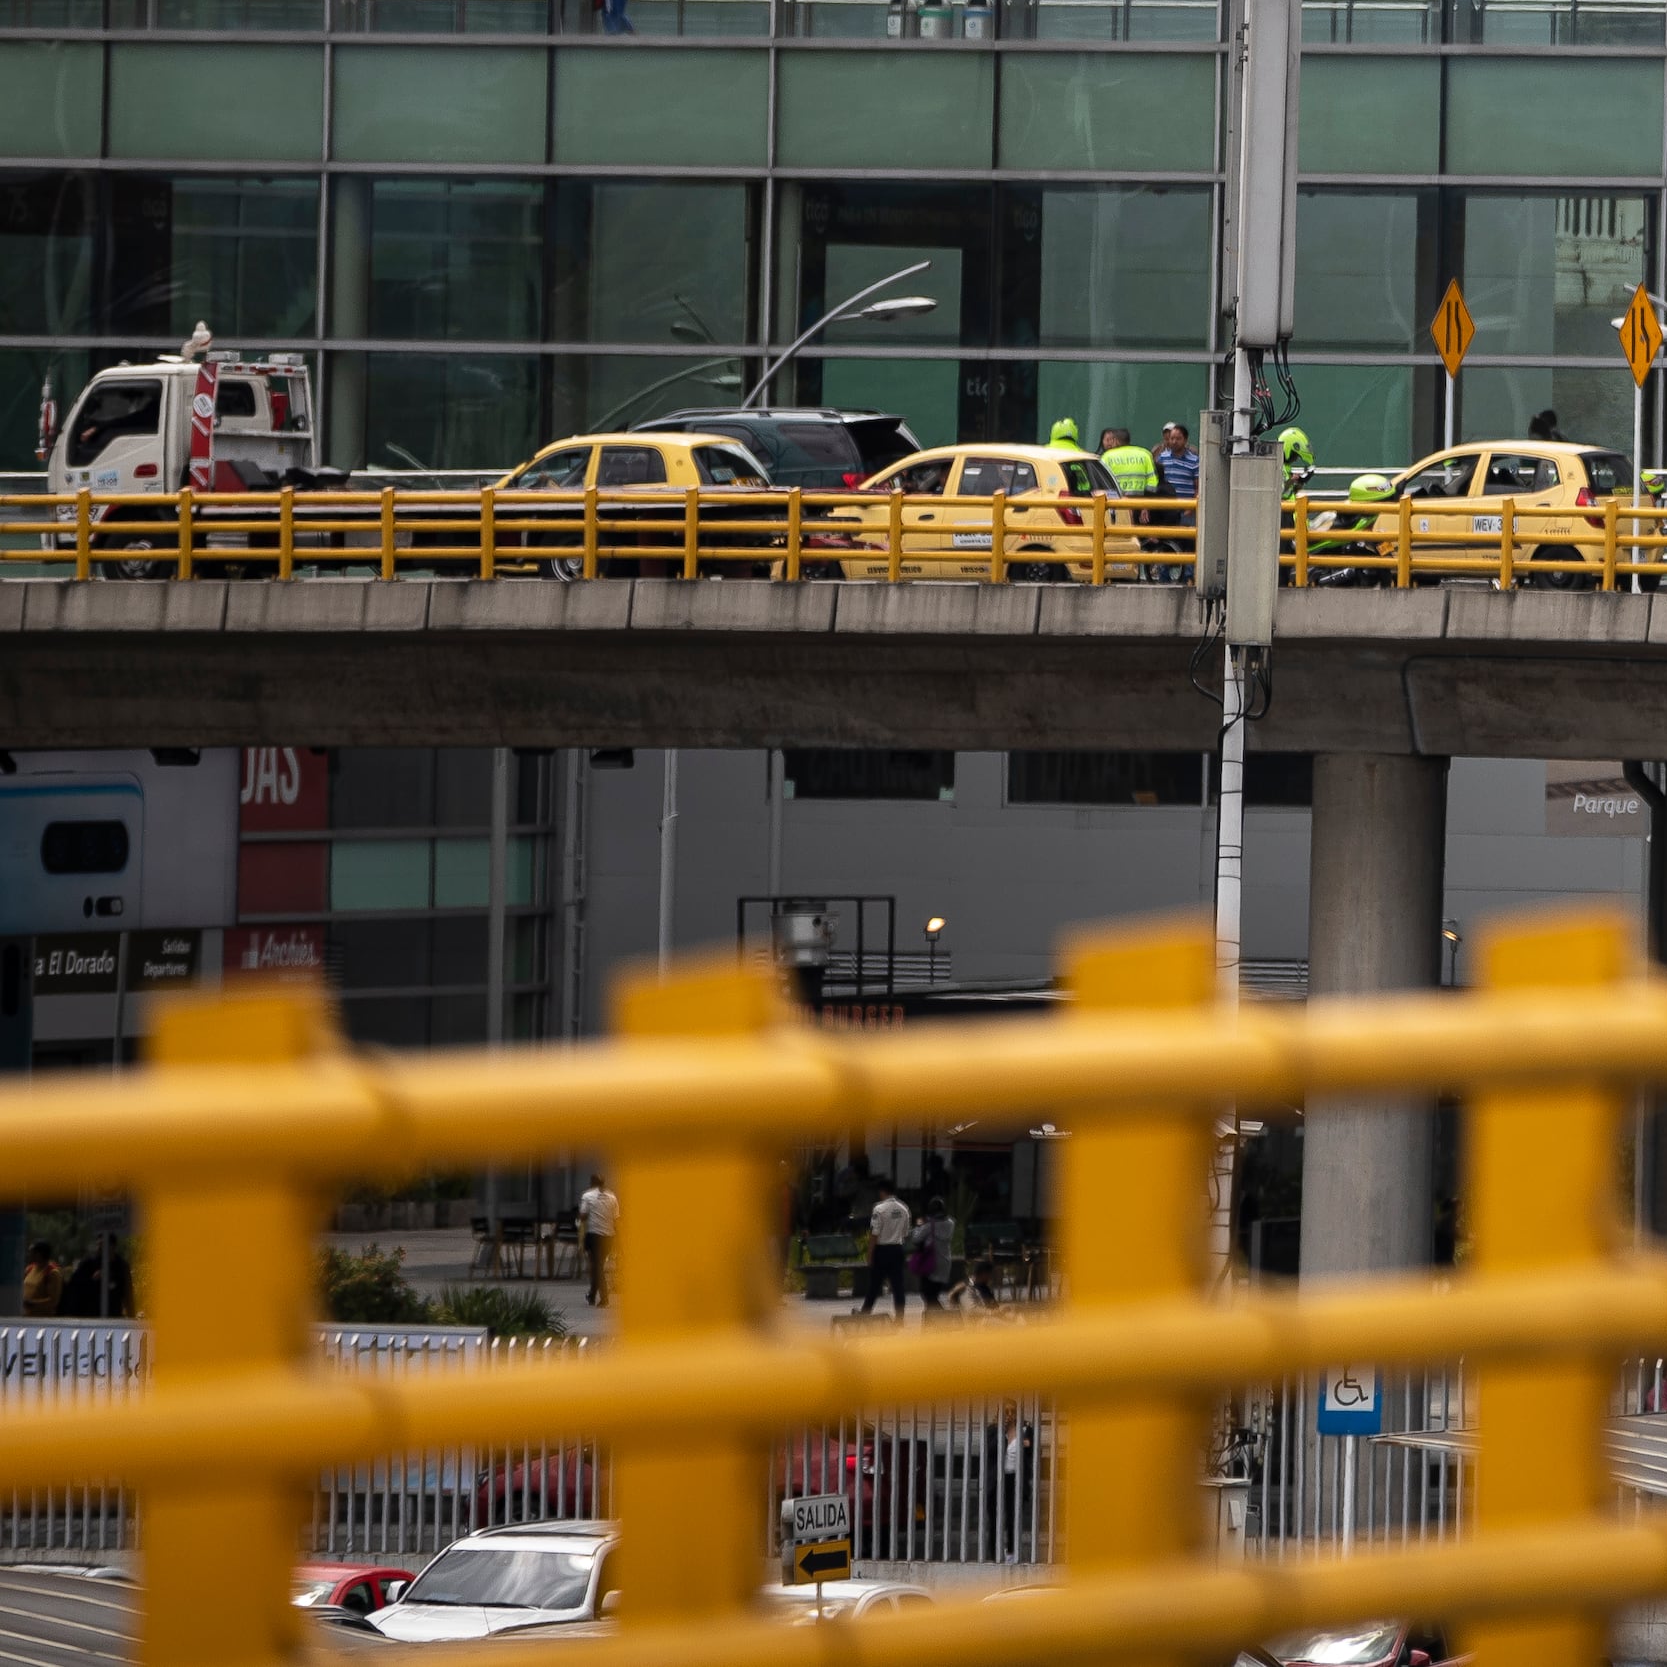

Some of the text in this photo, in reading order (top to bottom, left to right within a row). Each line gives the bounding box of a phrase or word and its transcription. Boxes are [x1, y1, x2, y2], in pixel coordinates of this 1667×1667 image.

[1572, 793, 1639, 819] Parque
[48, 951, 62, 976] El
[65, 949, 115, 975] Dorado
[795, 1500, 848, 1534] SALIDA
